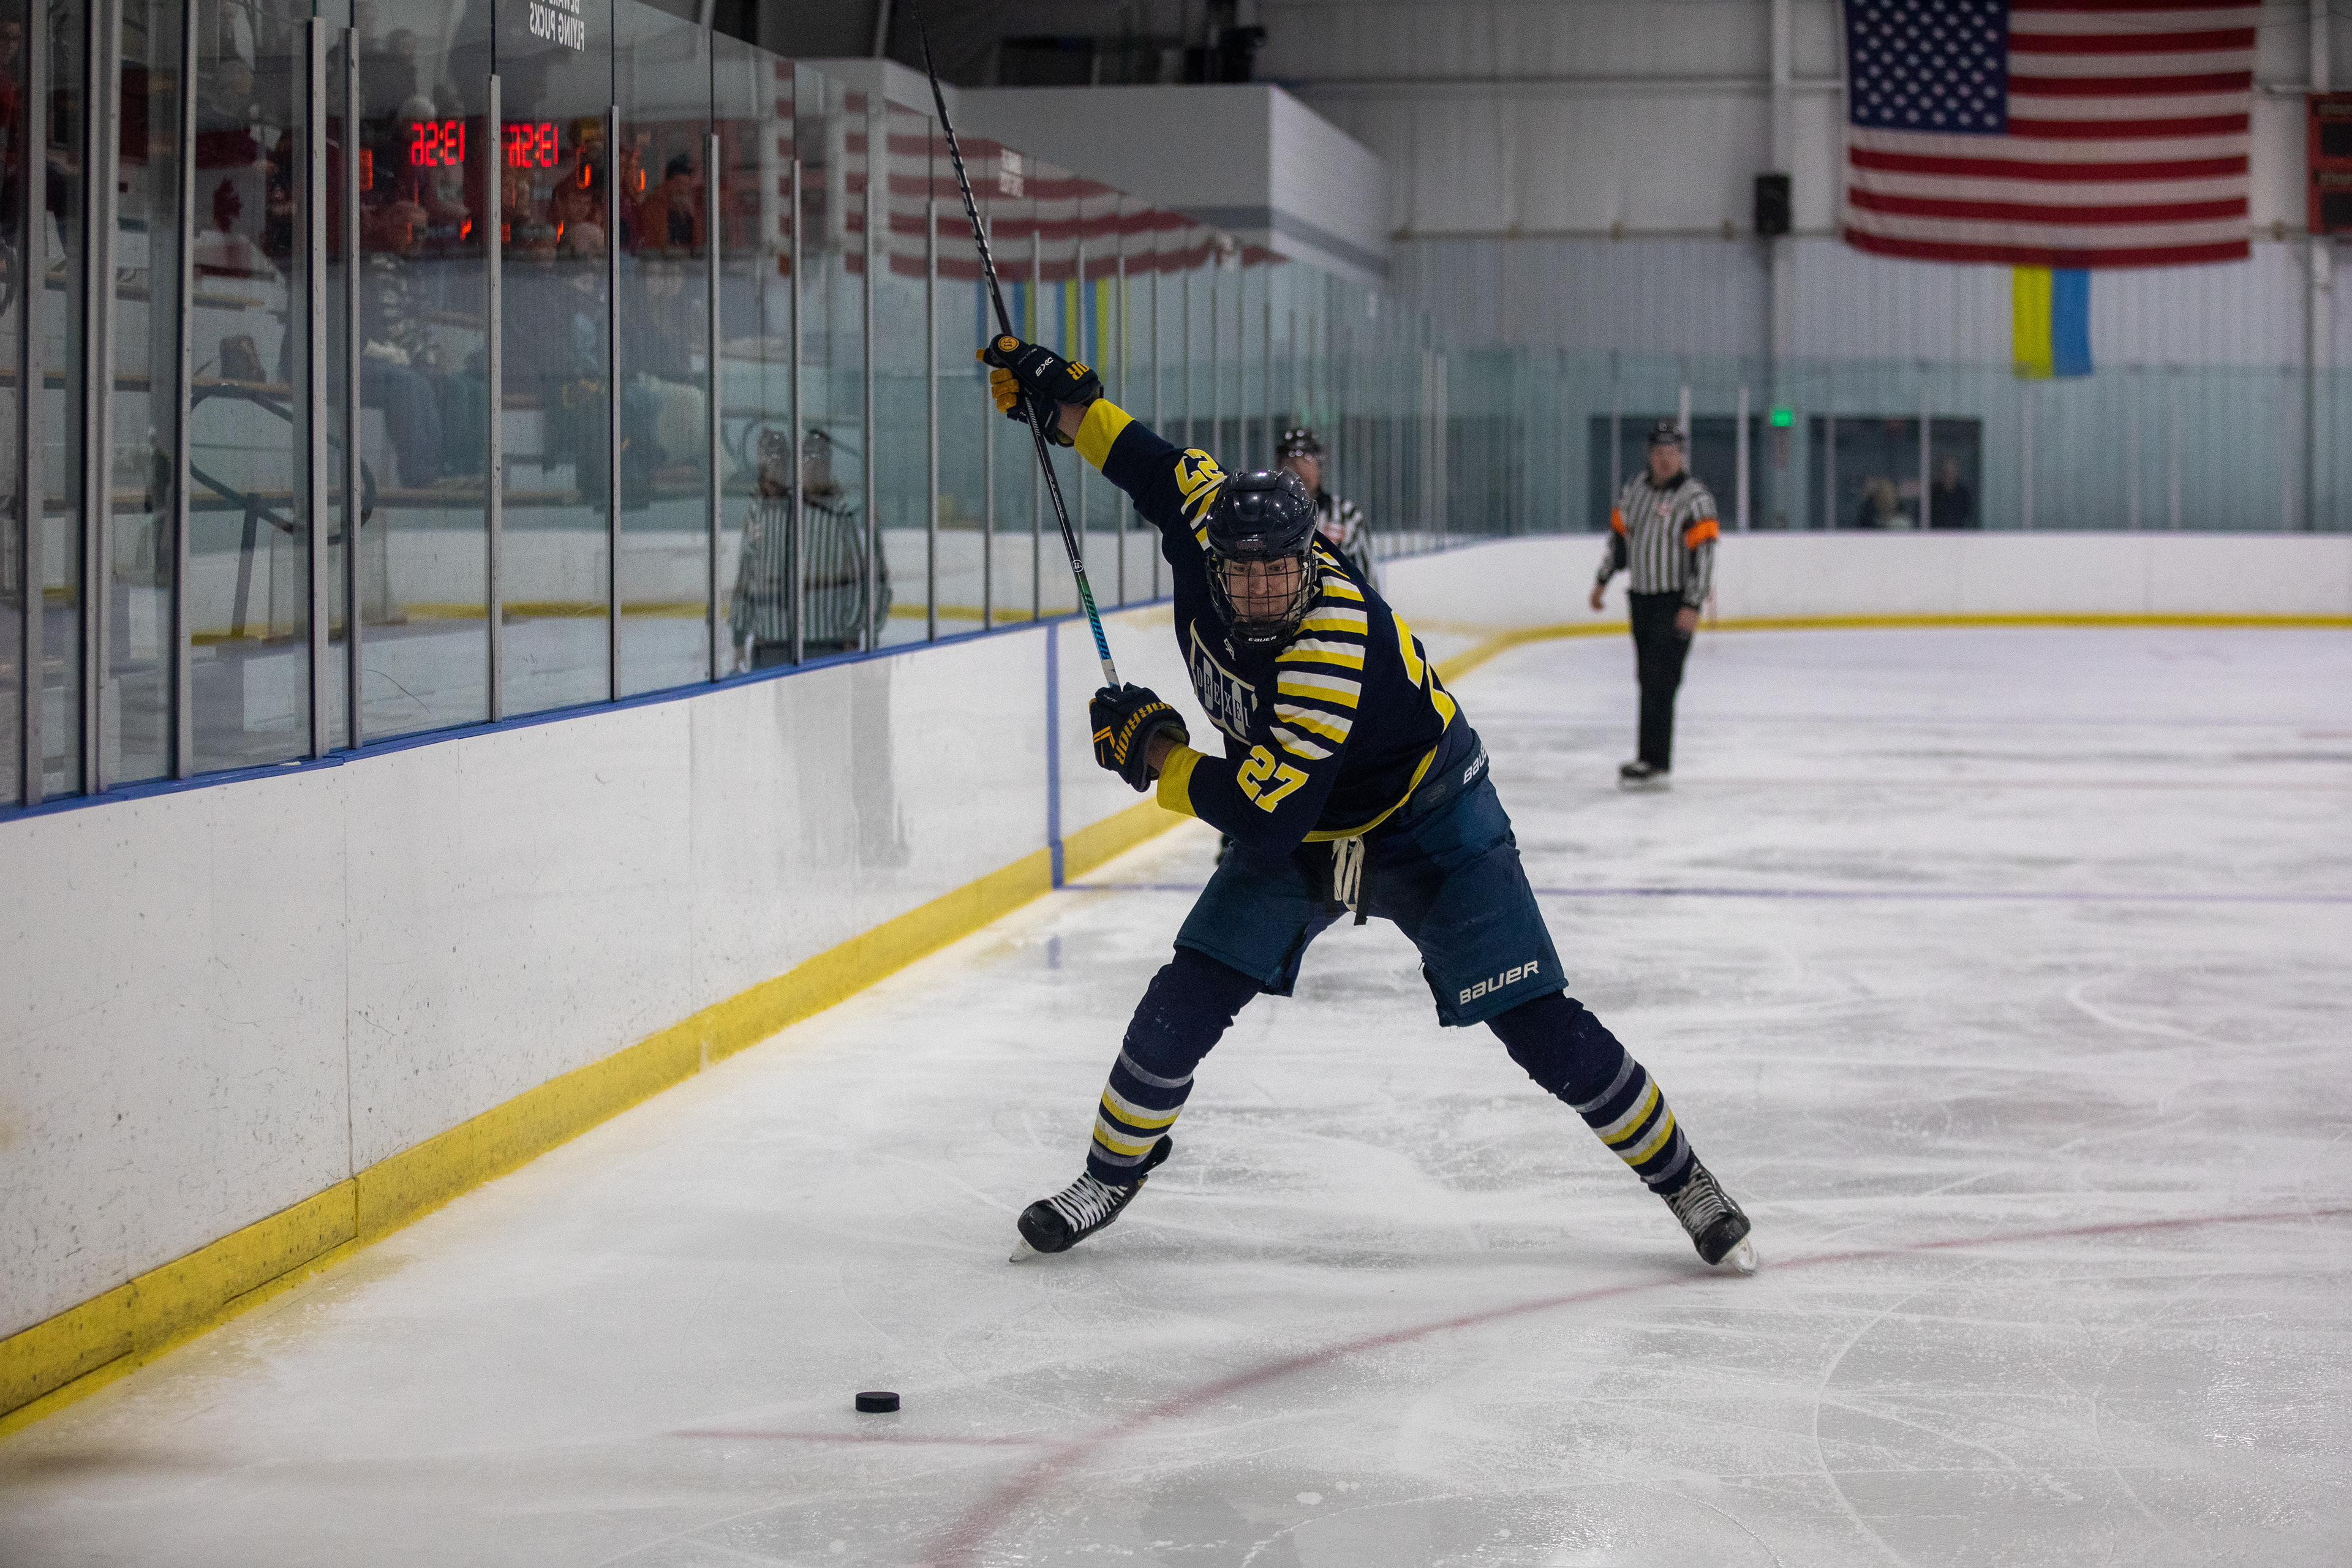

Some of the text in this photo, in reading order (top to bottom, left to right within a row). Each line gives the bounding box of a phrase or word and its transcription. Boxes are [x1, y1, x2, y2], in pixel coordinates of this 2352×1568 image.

[1086, 594, 1110, 660] ARRIOR
[1237, 745, 1310, 813] 27
[1463, 742, 1487, 785] BAUE
[1460, 960, 1539, 1005] BAUER
